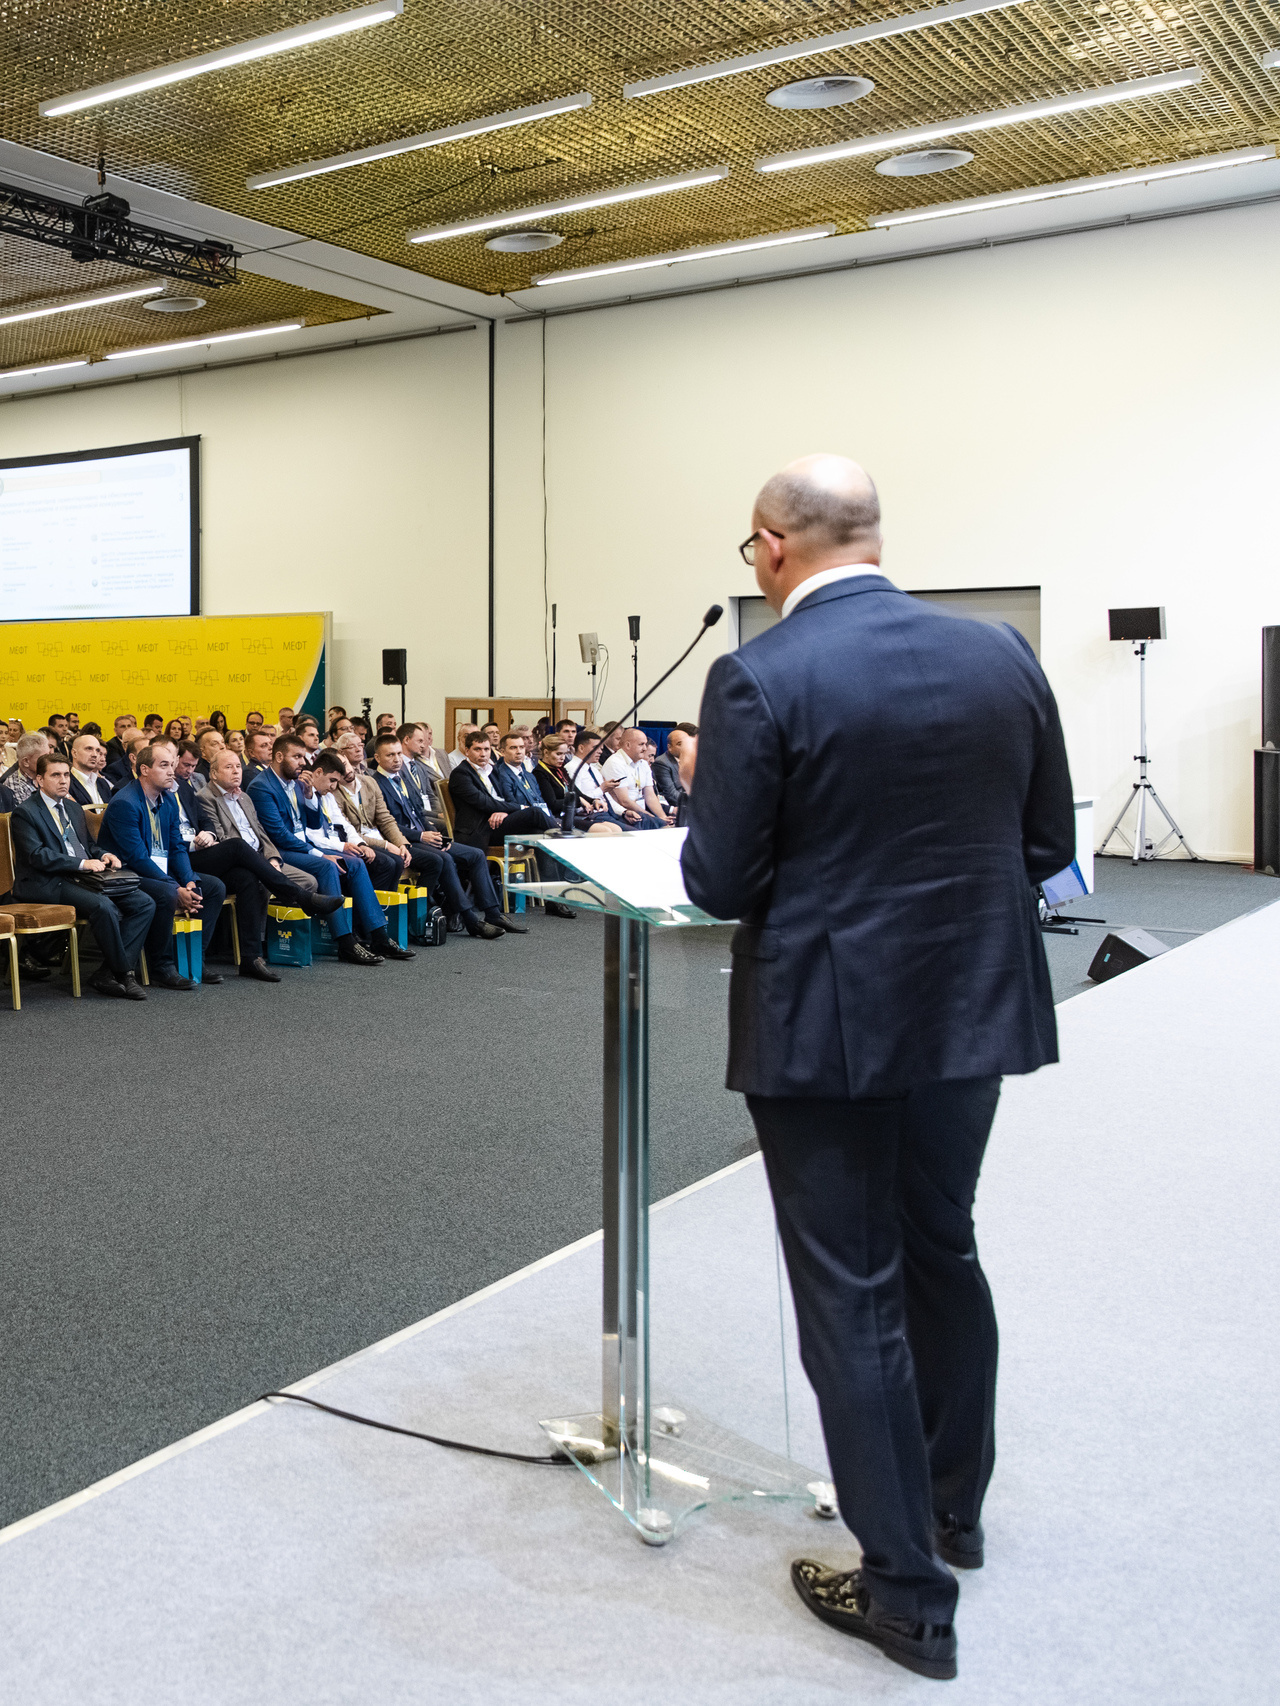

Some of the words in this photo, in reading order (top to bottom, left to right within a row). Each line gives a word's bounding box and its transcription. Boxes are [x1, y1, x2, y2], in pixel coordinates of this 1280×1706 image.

[71, 645, 91, 654] МЕФТ
[137, 643, 159, 652] МЕФТ
[207, 642, 230, 651] МЕФТ
[283, 641, 307, 650] МЕФТ
[9, 646, 28, 655] МЕФТ
[26, 674, 46, 683] МЕФТ
[89, 674, 110, 683] МЕФТ
[156, 674, 178, 683] МЕФТ
[228, 673, 252, 683] МЕФТ
[10, 702, 28, 711] МЕФТ
[71, 703, 91, 712] МЕФТ
[137, 703, 159, 712] МЕФТ
